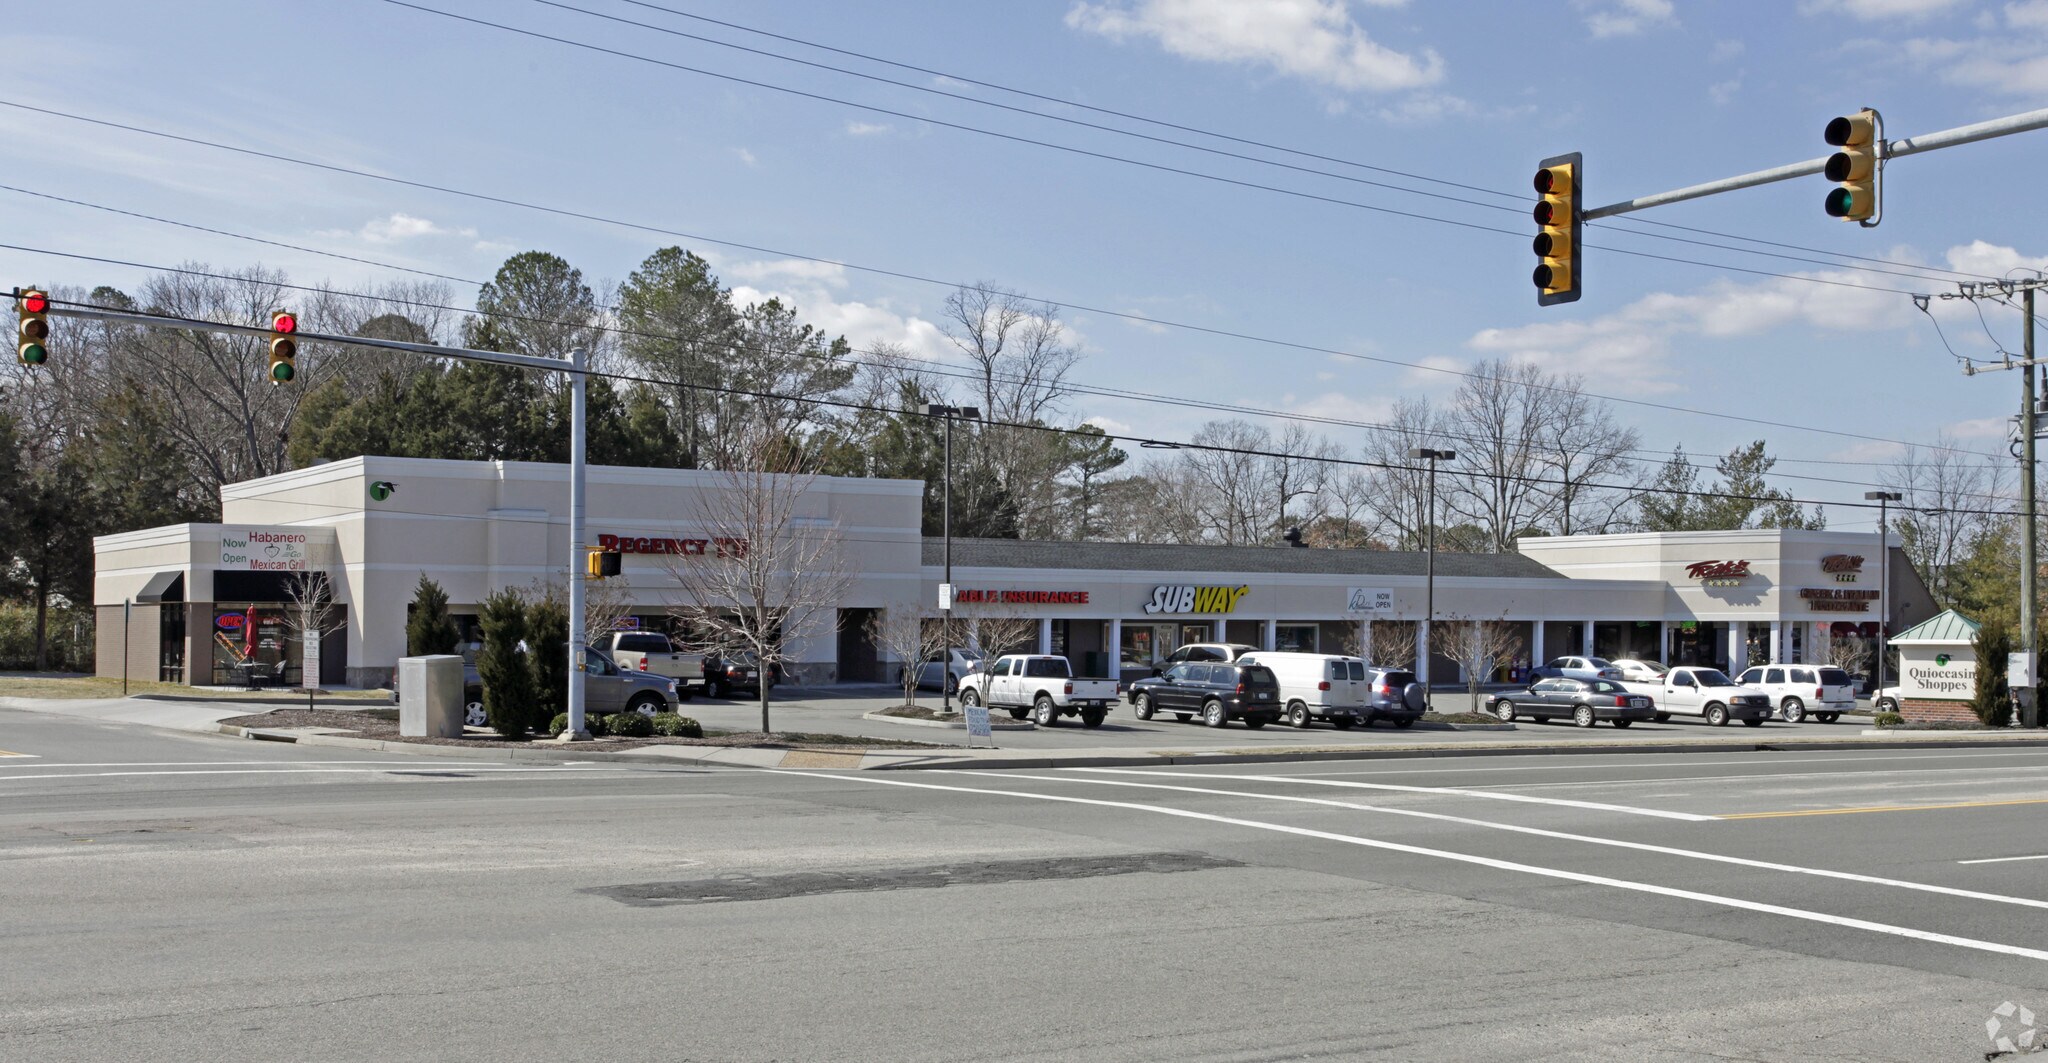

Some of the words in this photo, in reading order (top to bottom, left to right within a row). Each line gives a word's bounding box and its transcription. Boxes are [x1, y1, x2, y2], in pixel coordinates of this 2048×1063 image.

[222, 538, 247, 548] Now
[248, 531, 306, 543] Habanero
[285, 543, 295, 551] To
[222, 552, 247, 564] Open
[290, 550, 302, 558] Go
[249, 558, 287, 570] Mexican
[288, 558, 306, 570] Grill
[956, 589, 998, 604] ABLE
[1001, 590, 1090, 604] INSURANCE
[1143, 584, 1250, 615] SUBWAY
[1376, 592, 1391, 600] NOW
[1375, 600, 1392, 609] OPEN
[218, 615, 244, 627] OPEN
[1909, 667, 1976, 680] Quioccasin
[1917, 678, 1968, 692] Shoppes
